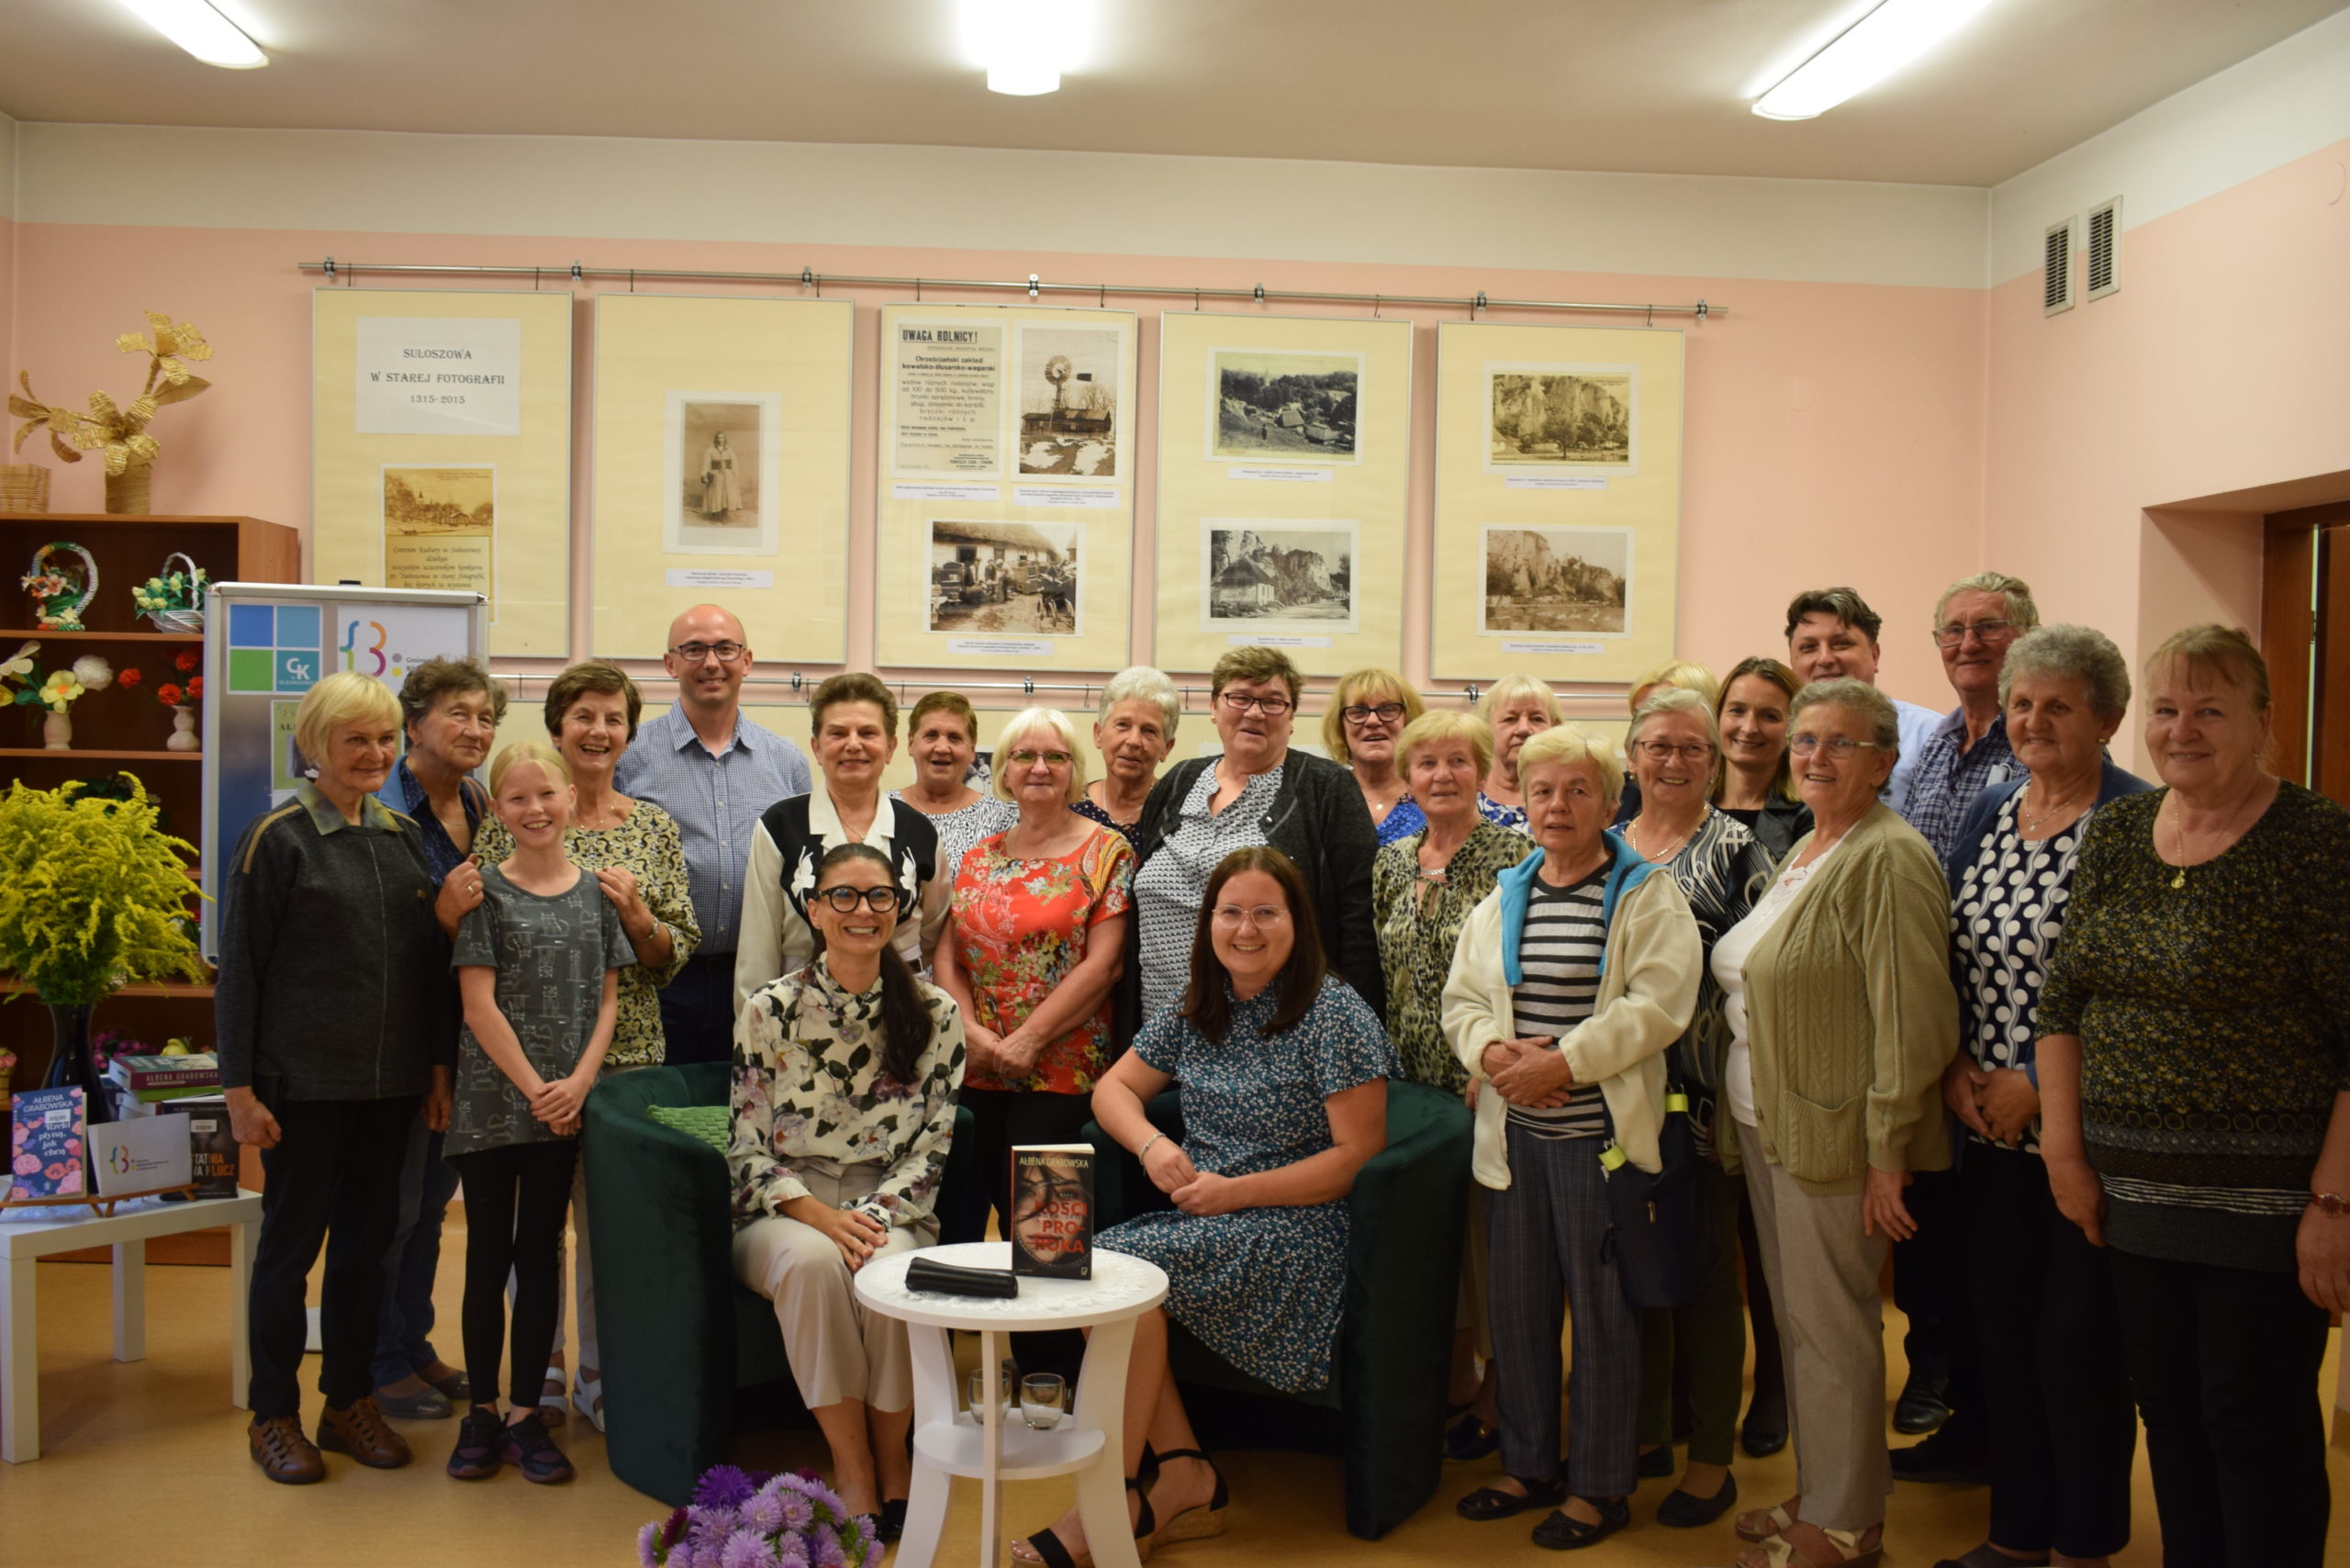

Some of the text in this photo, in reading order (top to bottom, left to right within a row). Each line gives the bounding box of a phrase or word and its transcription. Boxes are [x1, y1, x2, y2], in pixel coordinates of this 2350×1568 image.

[902, 330, 978, 342] UWAGA ROLNICY!
[403, 348, 472, 359] SUŁOSZOWA
[371, 371, 505, 385] W STAREJ FOTOGRAFII
[23, 1100, 73, 1113] GRABOWSKA
[42, 1139, 58, 1149] jak
